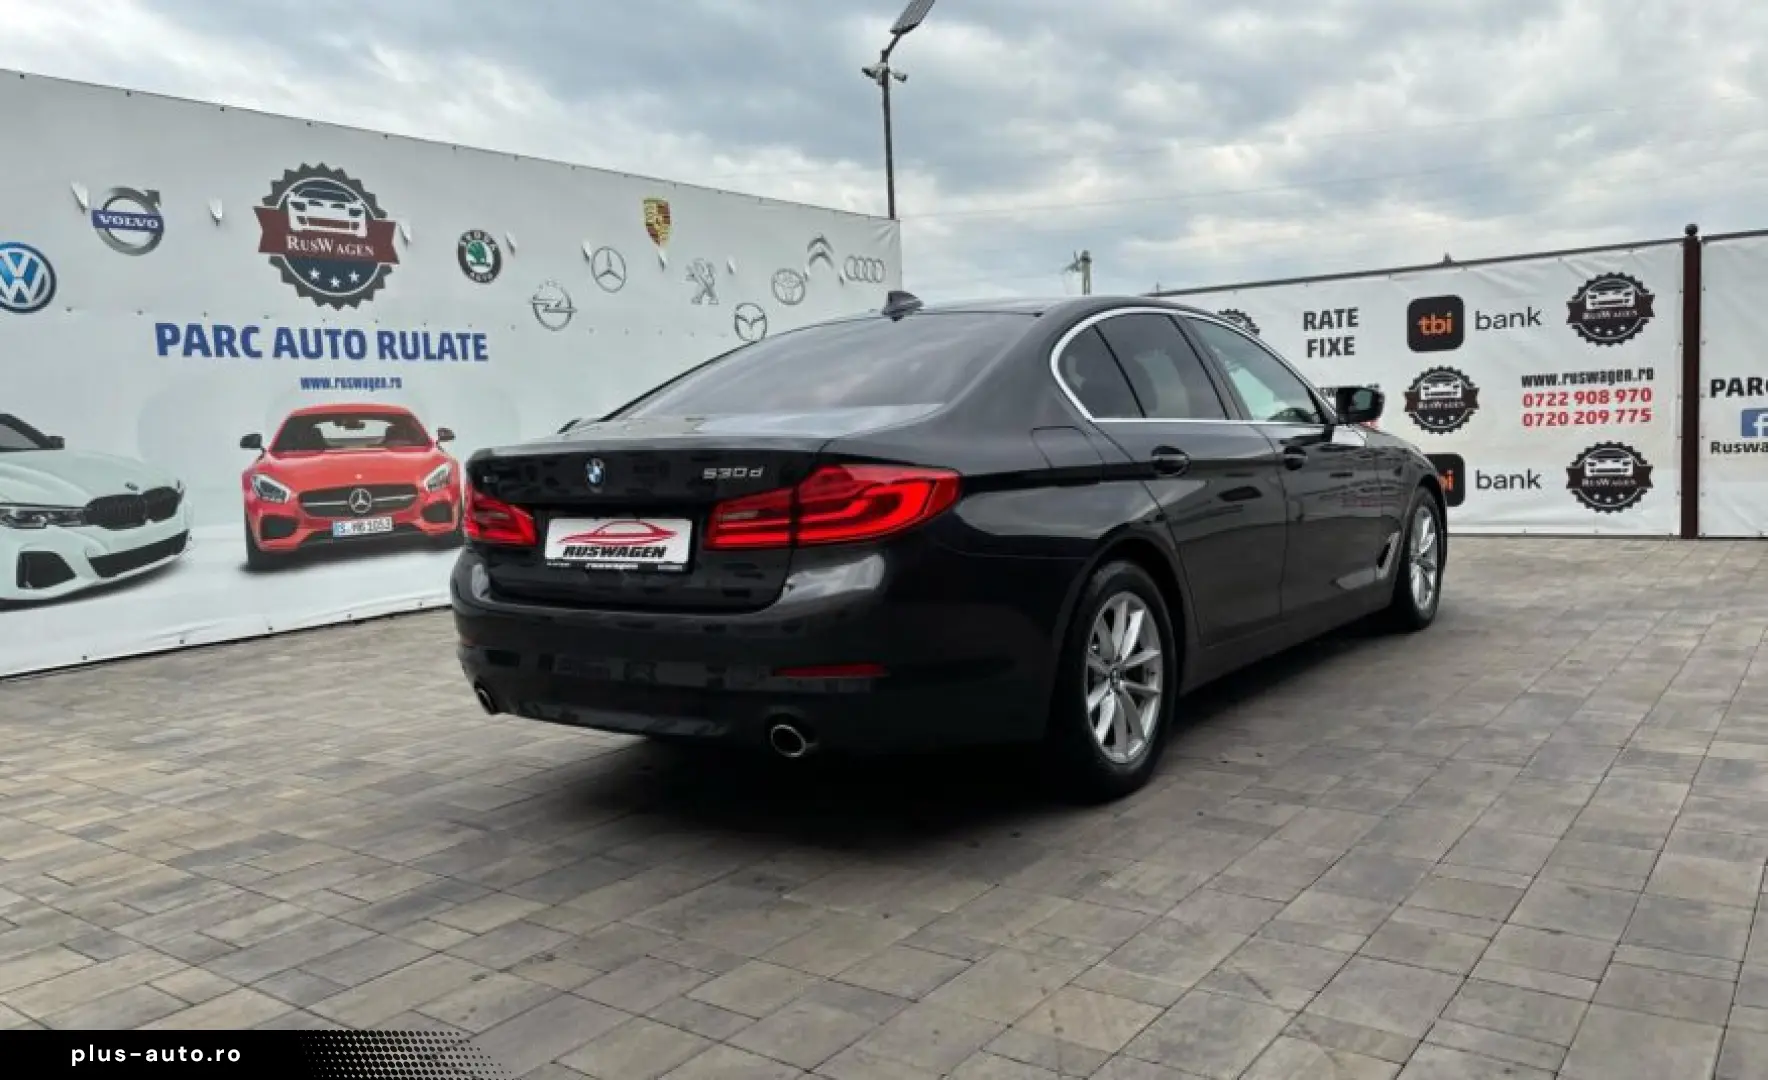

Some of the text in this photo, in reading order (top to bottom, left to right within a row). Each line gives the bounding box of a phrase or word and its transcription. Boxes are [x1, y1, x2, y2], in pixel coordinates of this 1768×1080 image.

[97, 214, 159, 229] VOLVO
[1303, 307, 1359, 331] RATE
[1417, 306, 1542, 335] tbi bank
[155, 322, 489, 362] PARC AUTO RULATE
[1307, 336, 1355, 358] FIXE
[300, 376, 402, 392] www.ruswagen.ro
[1521, 367, 1654, 388] www.ruswagen.ro
[1522, 387, 1652, 408] 0722 908 970
[1522, 407, 1652, 427] 0720 209 775
[703, 466, 764, 480] 530d
[1475, 468, 1543, 490] bank
[562, 545, 668, 558] RUSWAGEN
